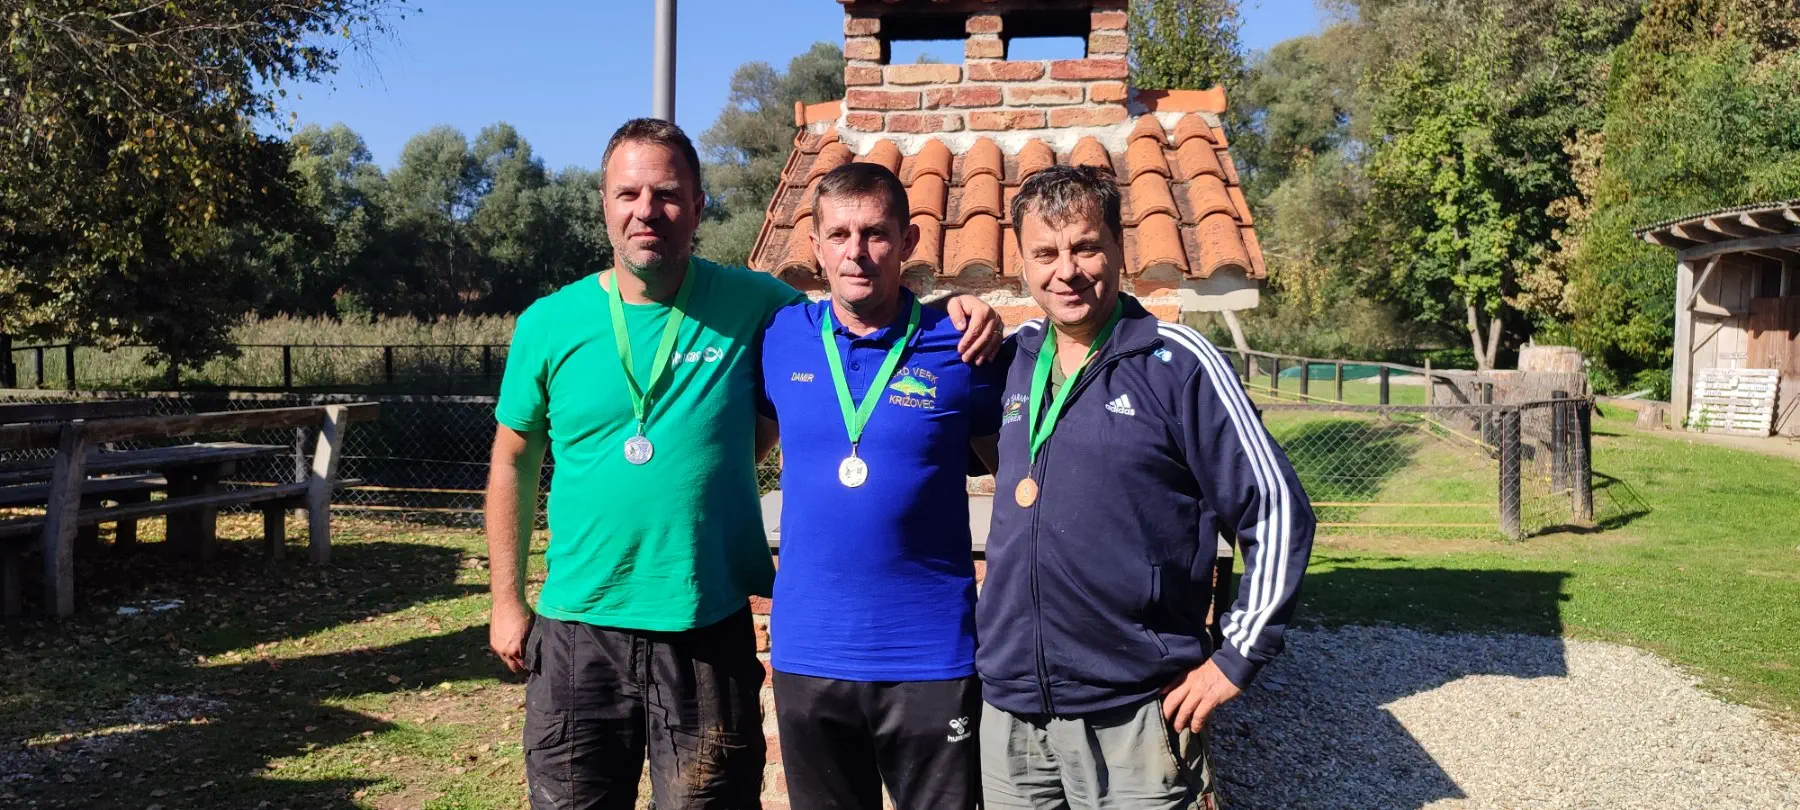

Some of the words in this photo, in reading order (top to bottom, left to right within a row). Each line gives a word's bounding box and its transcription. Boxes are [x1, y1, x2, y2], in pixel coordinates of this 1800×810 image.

[791, 371, 815, 383] DAMIR
[913, 367, 939, 383] VERK
[889, 395, 935, 409] KRIŽOVEC
[1105, 404, 1135, 416] adidas
